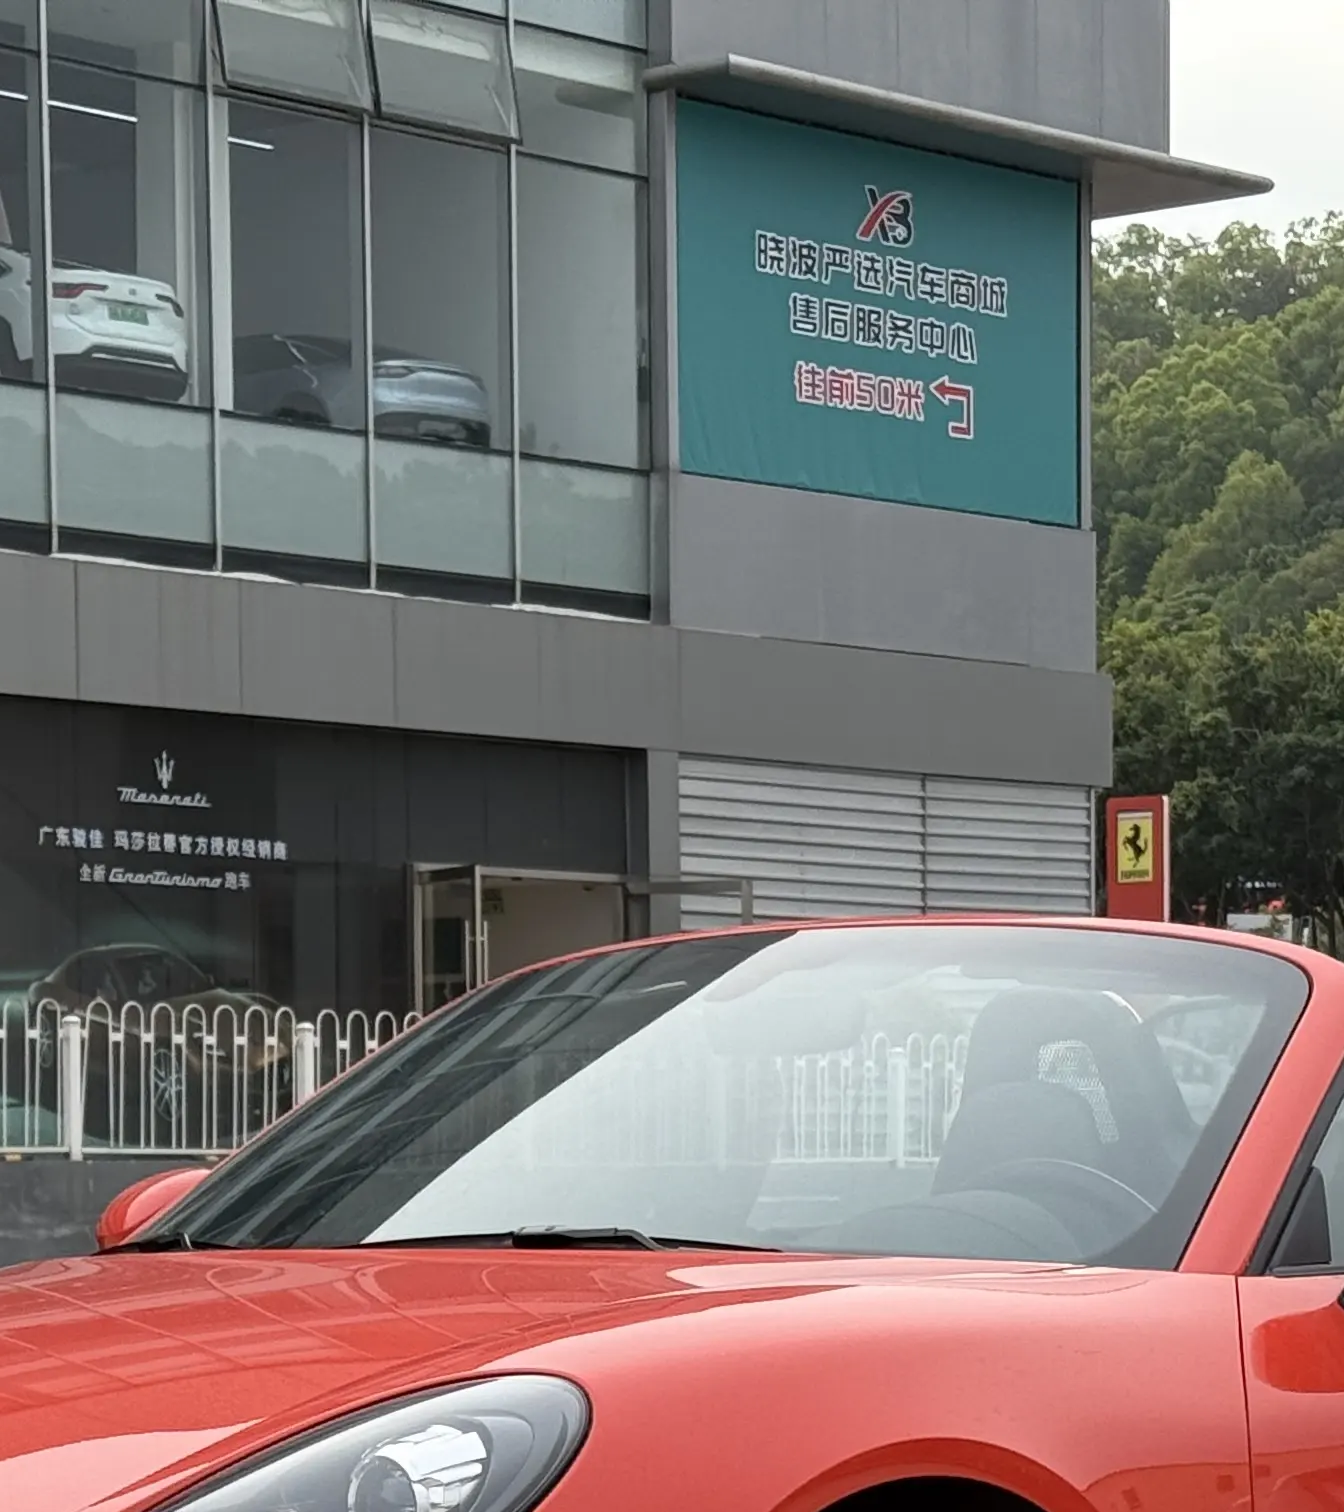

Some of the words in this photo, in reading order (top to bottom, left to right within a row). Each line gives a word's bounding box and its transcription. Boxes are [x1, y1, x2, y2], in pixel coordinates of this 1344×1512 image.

[755, 229, 1008, 318] 晓波严选汽车商城
[788, 292, 978, 364] 售后服务中心
[793, 360, 925, 422] 往前50米
[116, 785, 213, 809] Maserati
[108, 867, 223, 889] GranTurismo
